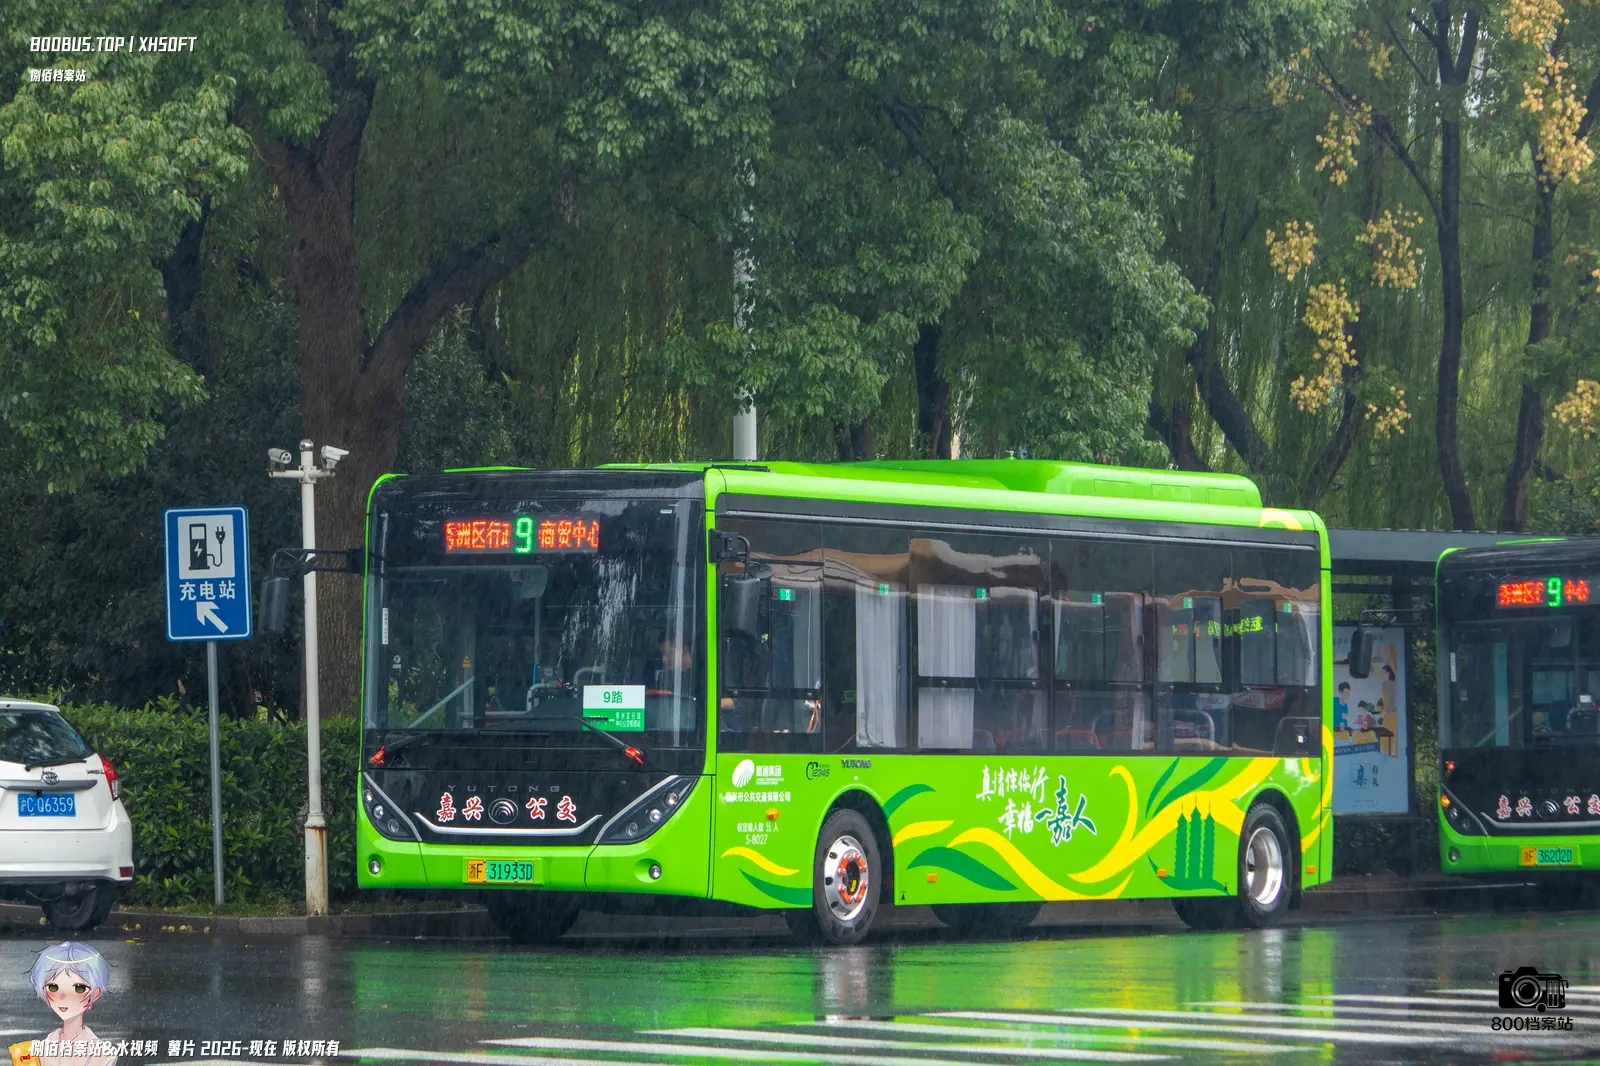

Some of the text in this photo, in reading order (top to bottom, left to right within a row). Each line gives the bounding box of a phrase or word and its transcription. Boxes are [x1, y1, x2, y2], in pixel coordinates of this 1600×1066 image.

[516, 518, 533, 553] 9
[539, 519, 599, 548] 商贸中心
[179, 580, 236, 601] 充电站
[1547, 577, 1561, 607] 9
[603, 691, 623, 704] 9路
[812, 769, 830, 777] 12345
[448, 785, 560, 793] YUTONG
[437, 792, 577, 823] 嘉兴 公交
[745, 834, 769, 845] 5-8027
